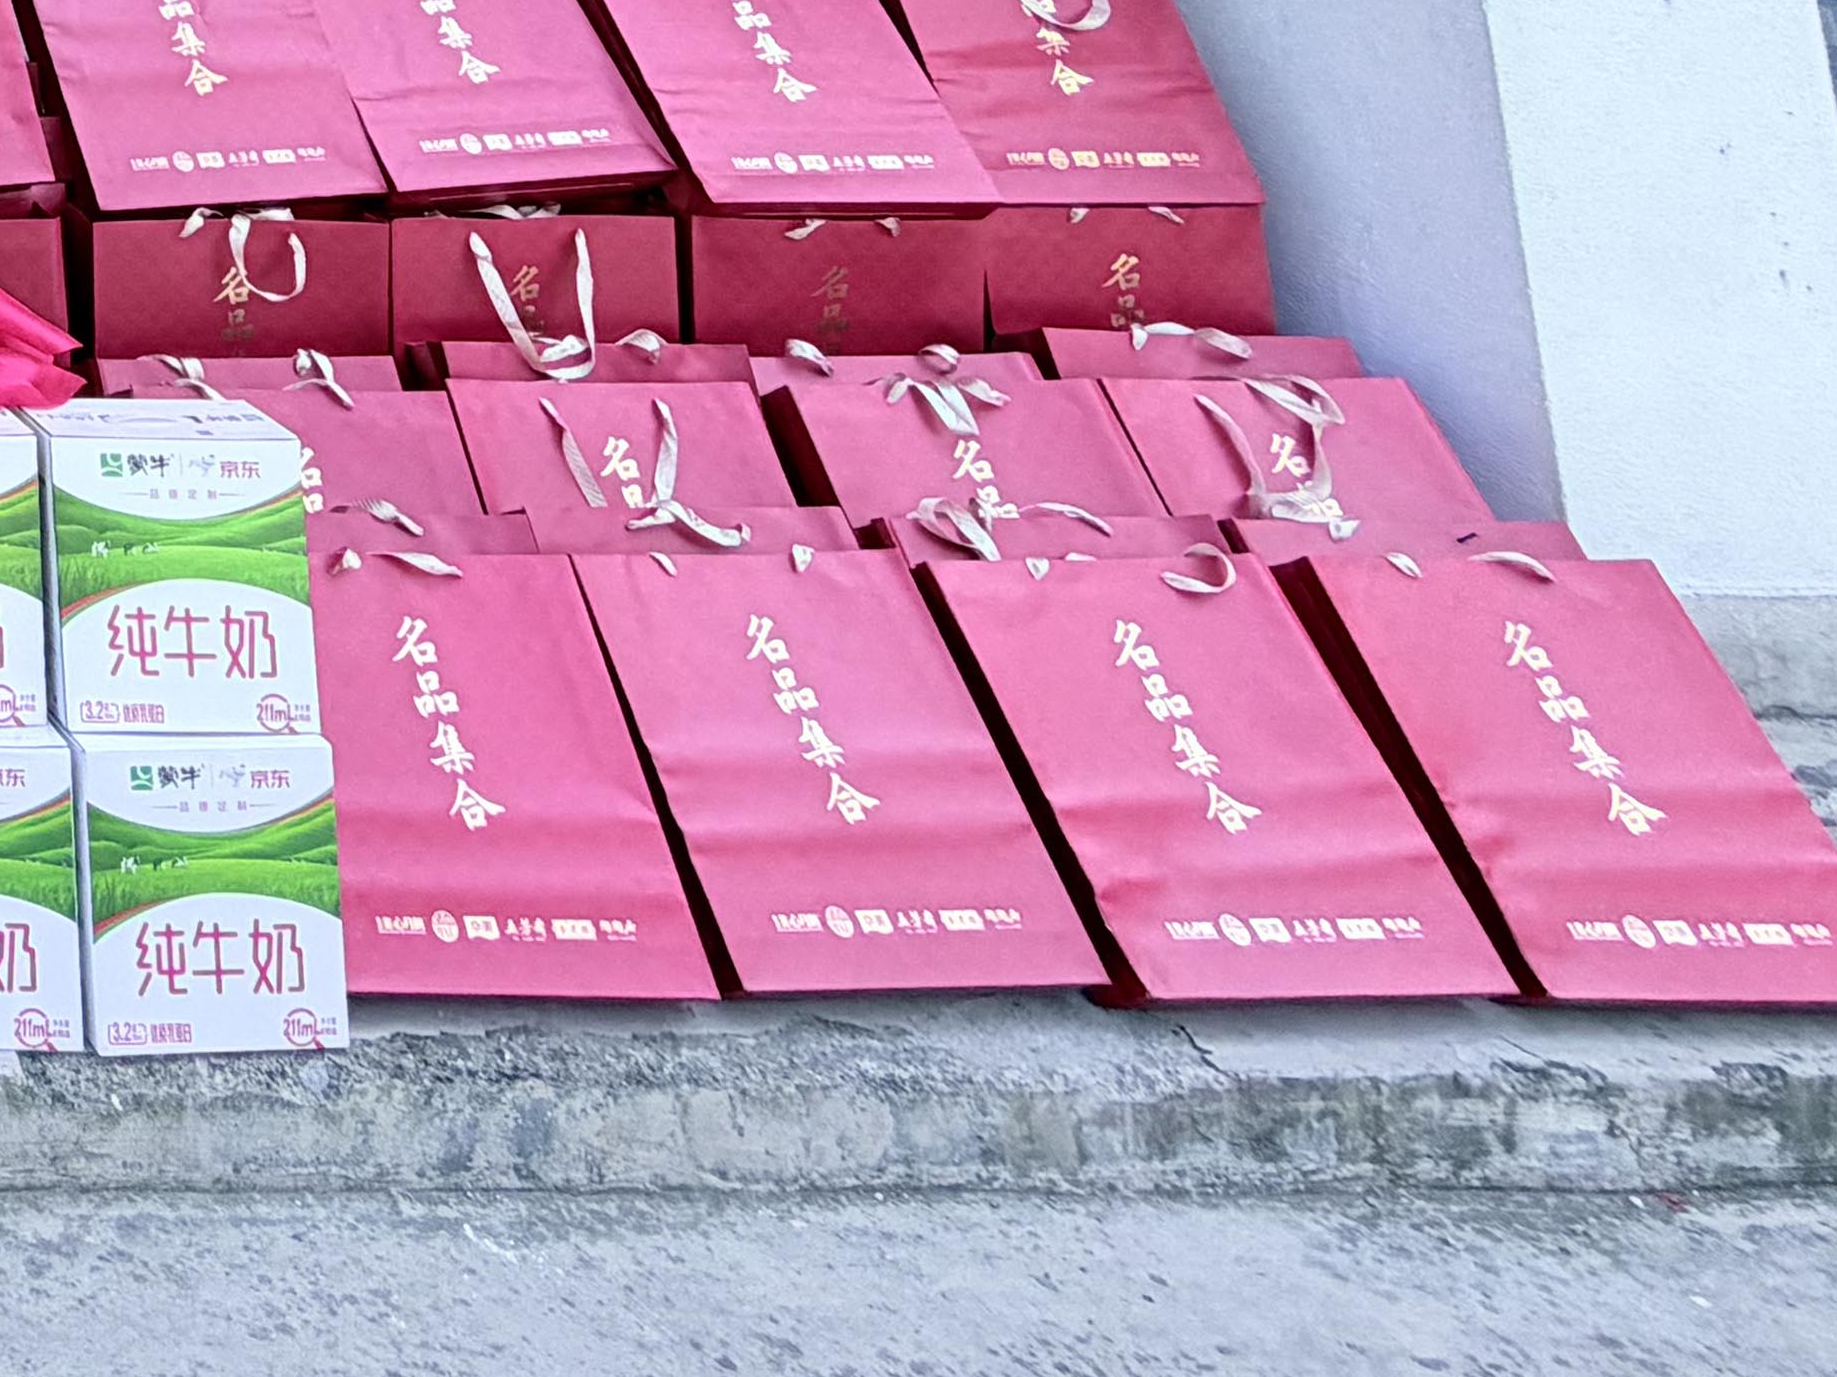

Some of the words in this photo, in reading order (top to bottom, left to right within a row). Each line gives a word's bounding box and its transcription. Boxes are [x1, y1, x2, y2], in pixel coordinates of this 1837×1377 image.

[127, 453, 172, 477] 蒙牛
[220, 461, 260, 478] 京东
[105, 603, 277, 679] 纯牛奶
[157, 764, 202, 789] 蒙牛
[250, 770, 290, 788] 京东
[393, 616, 506, 833] 名品集合
[746, 615, 881, 825] 名品集合
[1113, 620, 1262, 835] 名品集合
[1504, 620, 1669, 837] 名品集合
[134, 918, 304, 995] 纯牛奶
